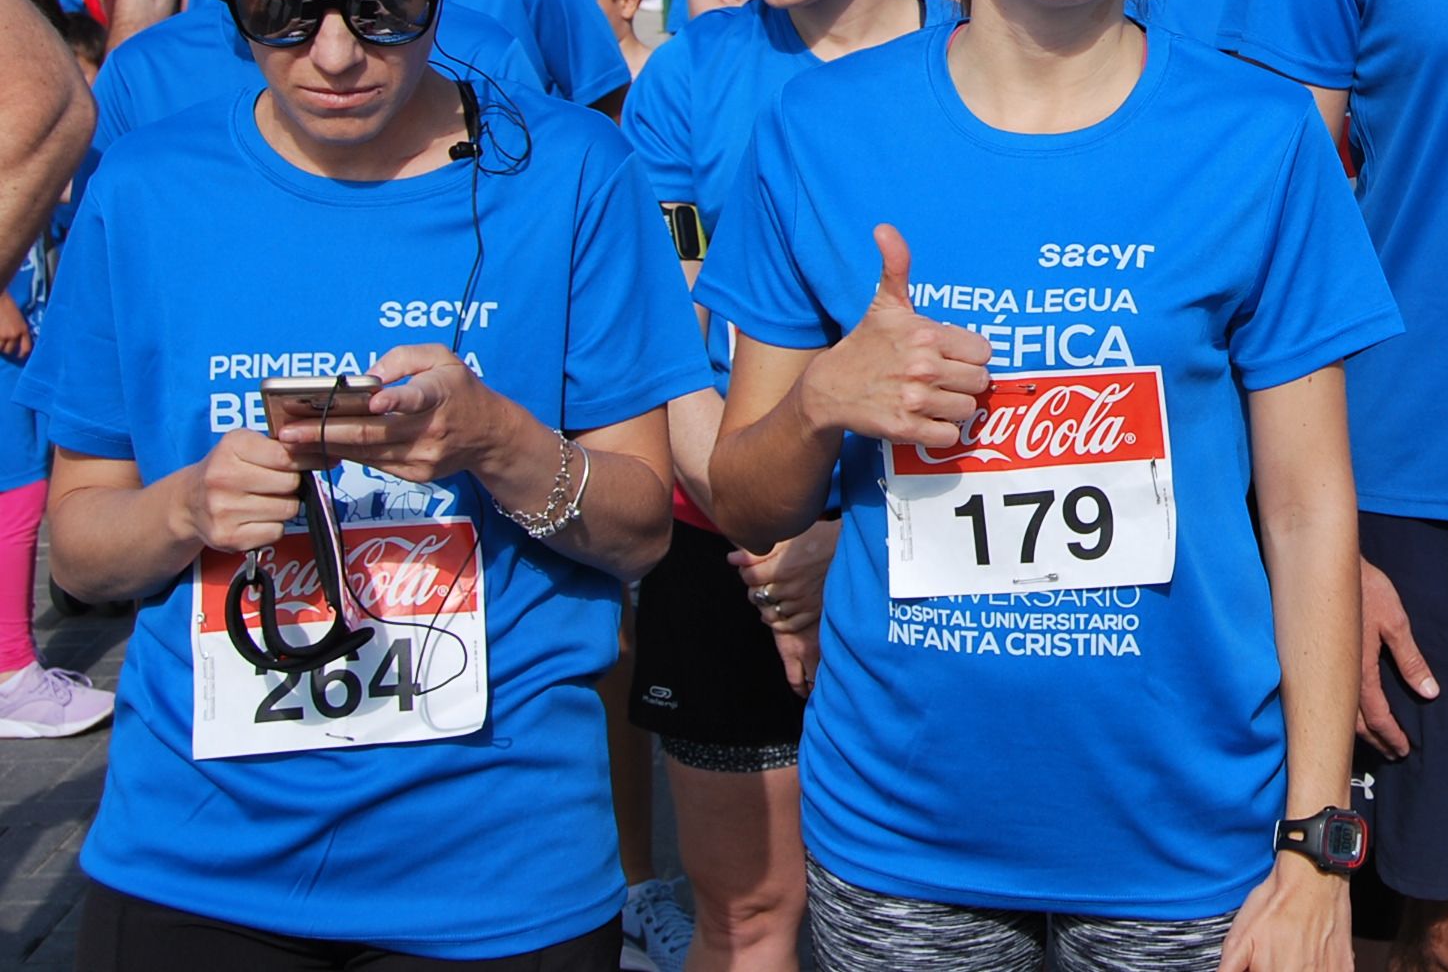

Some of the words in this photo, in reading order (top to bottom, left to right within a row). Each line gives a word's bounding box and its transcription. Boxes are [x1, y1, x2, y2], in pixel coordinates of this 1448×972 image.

[1038, 244, 1155, 270] sacyr
[876, 283, 1019, 313] IMERA
[1025, 288, 1138, 314] LEGUA
[379, 301, 498, 330] sacyr
[209, 352, 362, 380] PRIMERA
[955, 486, 1114, 565] 179
[889, 602, 977, 628] HOSPITAL
[980, 611, 1140, 631] UNIVERSITARIO
[888, 620, 1000, 656] INFANTA
[1005, 631, 1141, 657] CRISTINA
[254, 637, 421, 724] 264
